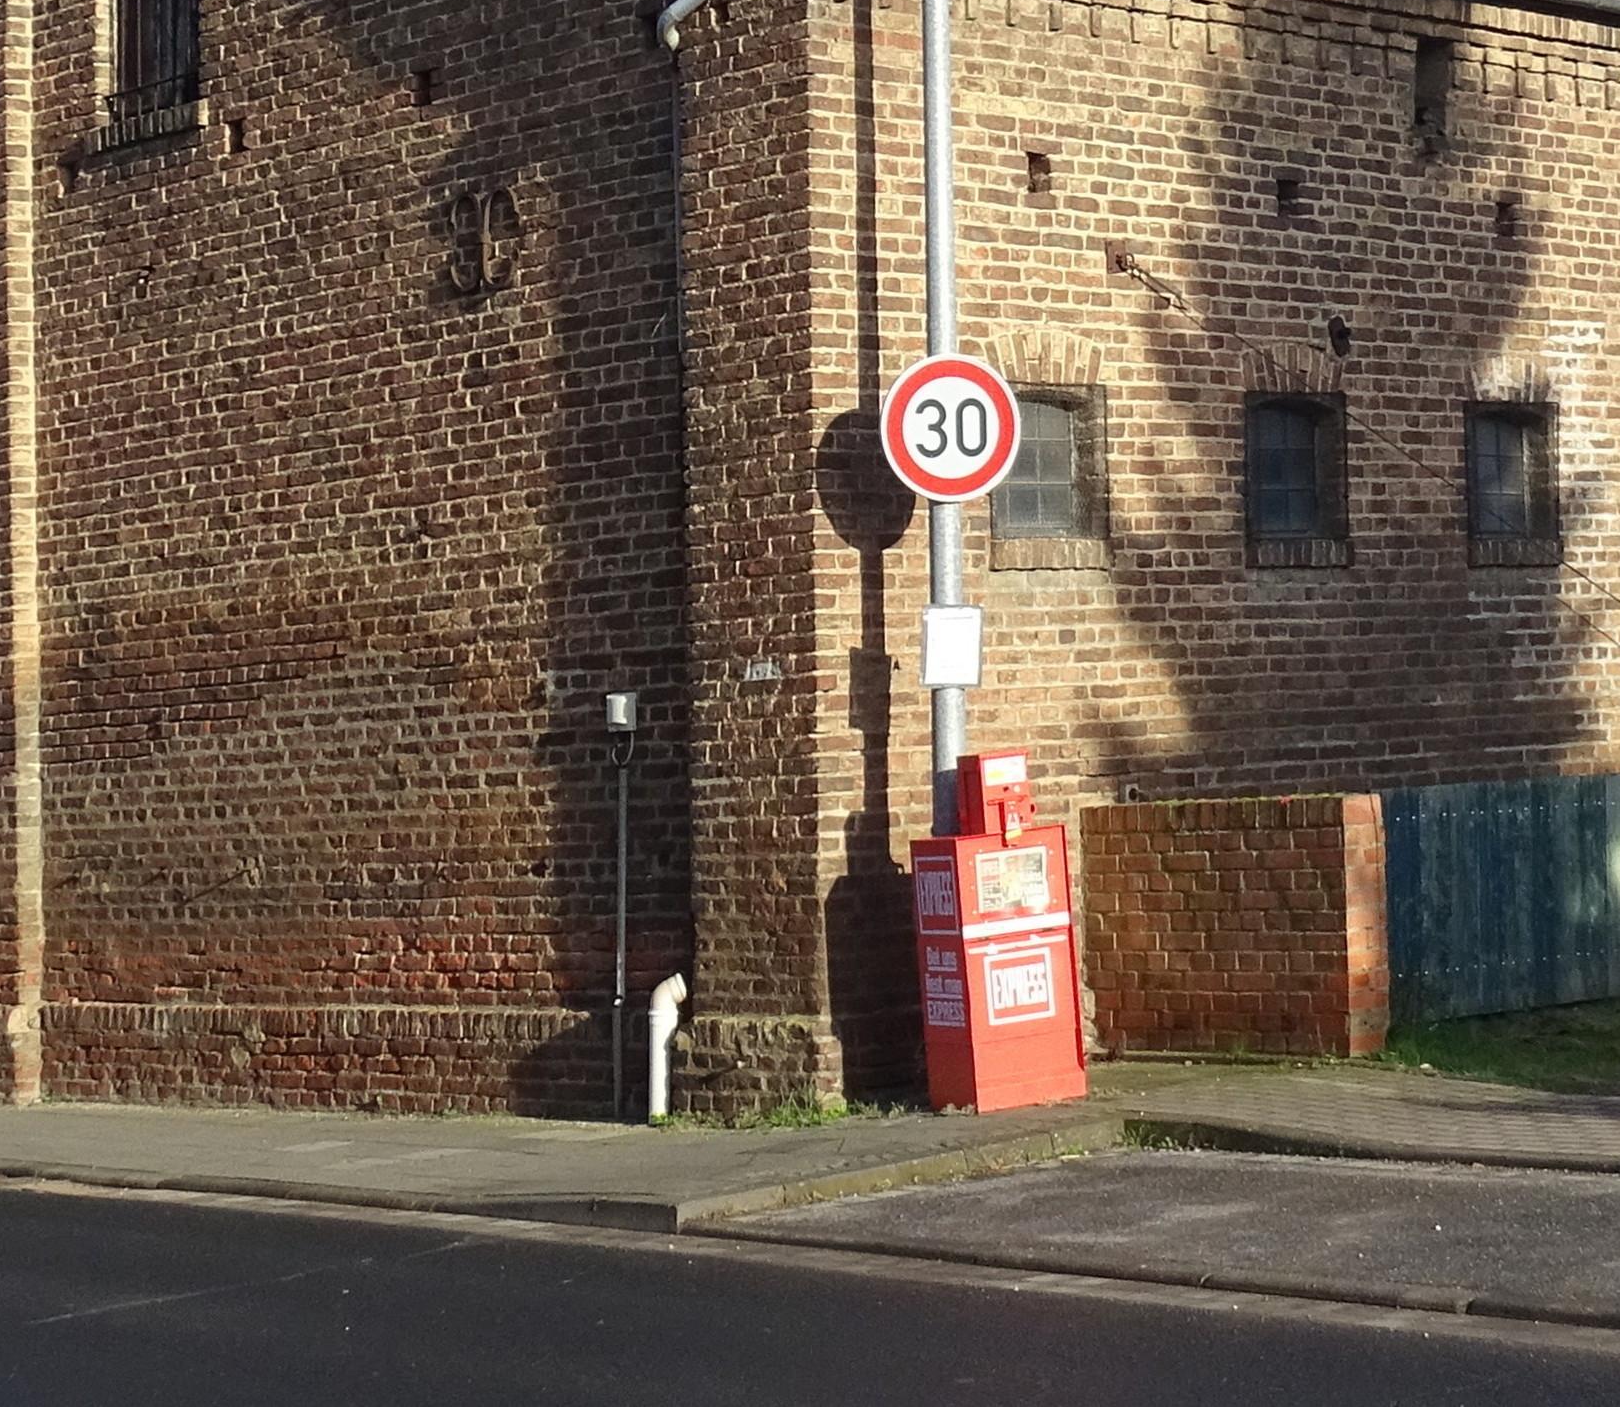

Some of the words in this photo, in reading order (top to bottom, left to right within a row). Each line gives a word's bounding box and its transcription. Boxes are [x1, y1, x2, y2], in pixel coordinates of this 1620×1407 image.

[915, 398, 987, 458] 30
[990, 962, 1048, 1010] EXPRESS
[927, 1000, 965, 1022] EXPRESS
